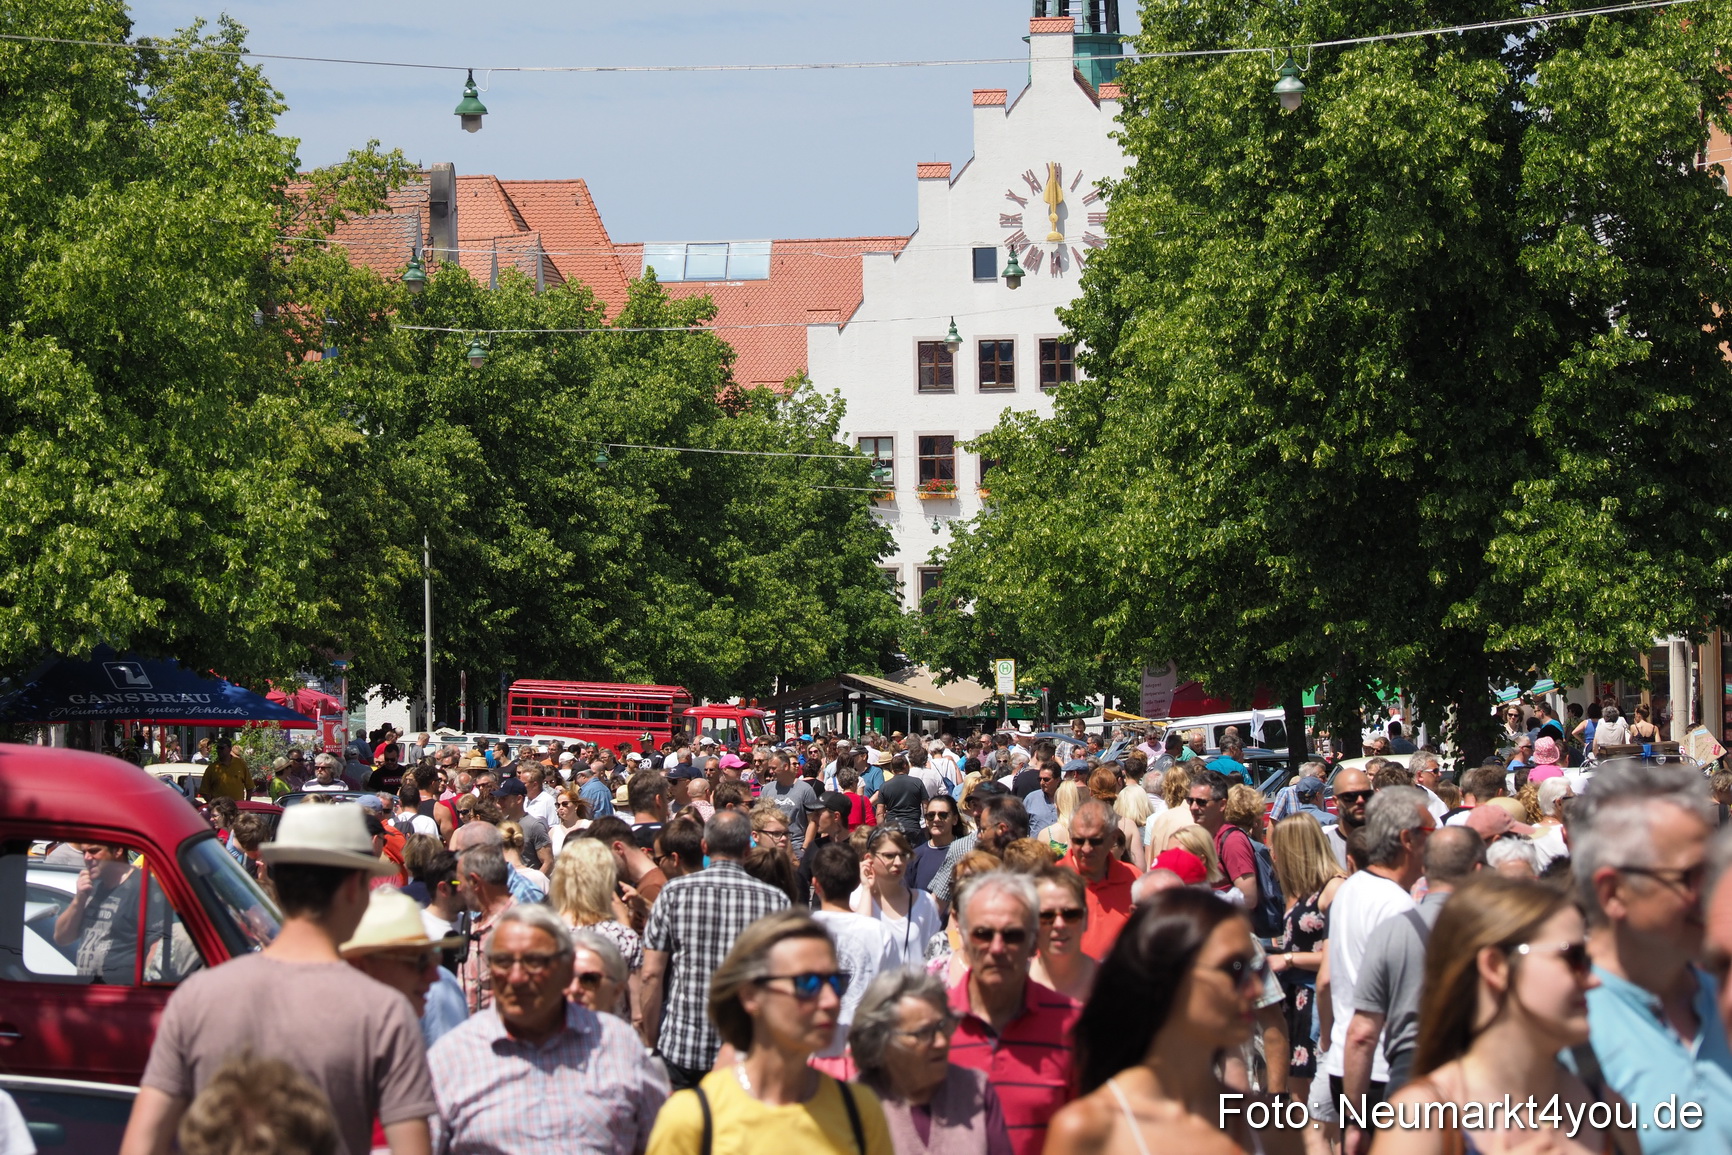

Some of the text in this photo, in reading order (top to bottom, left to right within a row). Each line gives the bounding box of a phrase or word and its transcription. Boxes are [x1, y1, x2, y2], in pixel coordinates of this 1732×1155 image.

[49, 706, 249, 717] Neumarkt's guter Schluck
